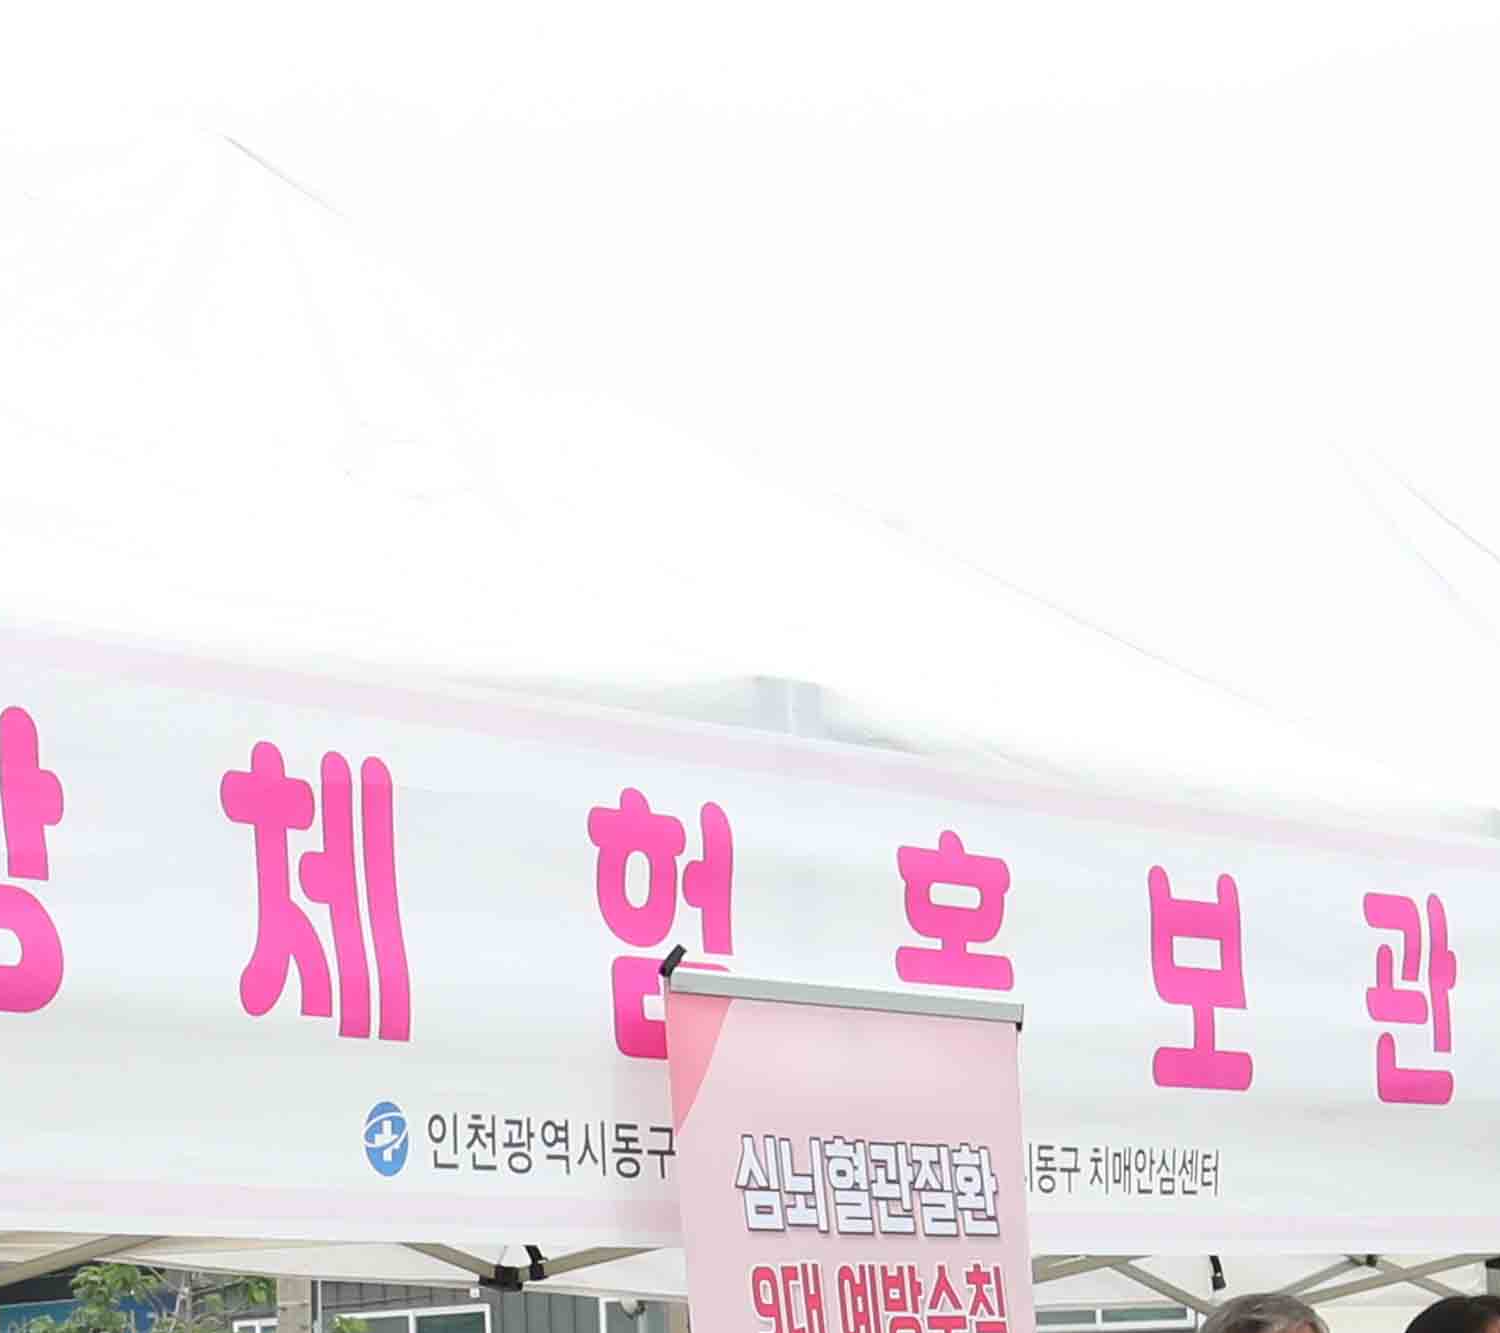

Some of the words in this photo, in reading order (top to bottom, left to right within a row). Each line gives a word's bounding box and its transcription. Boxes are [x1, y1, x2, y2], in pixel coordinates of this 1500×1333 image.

[735, 1134, 1000, 1238] 심뇌혈관질환
[1023, 1143, 1081, 1196] 동구
[1087, 1146, 1220, 1197] 치매안심센터
